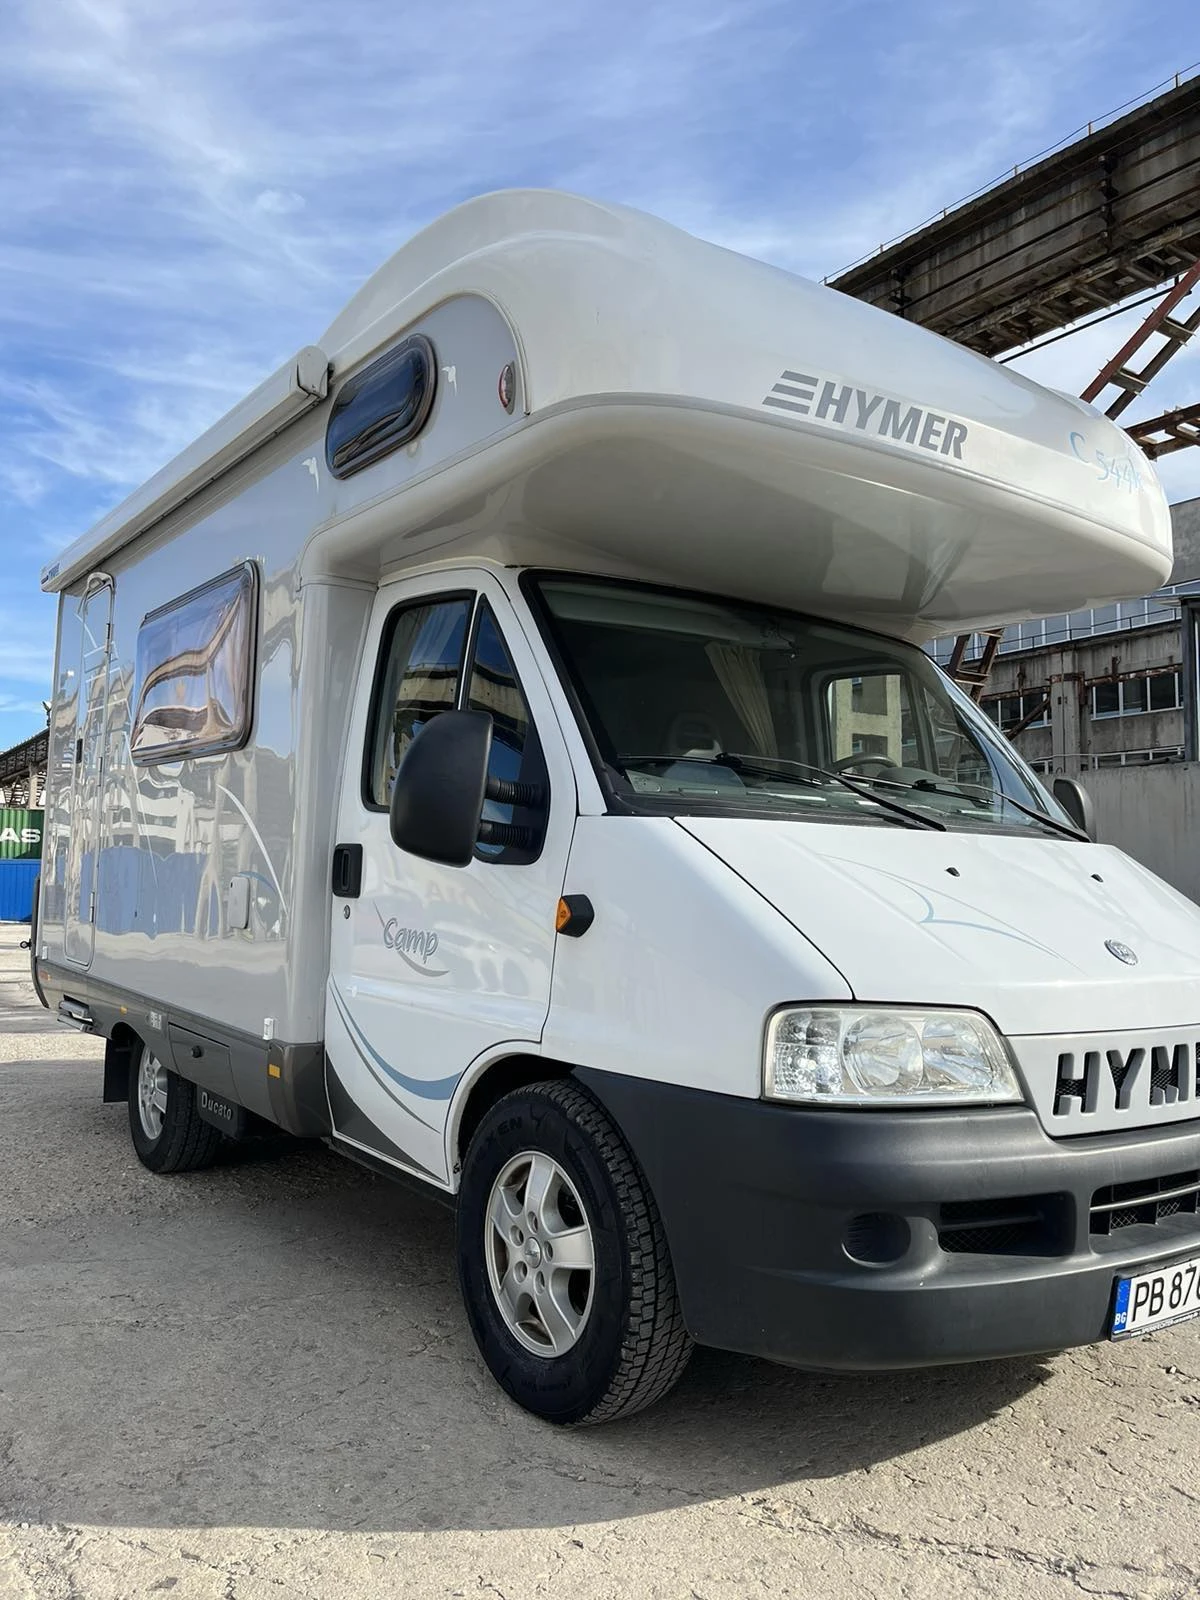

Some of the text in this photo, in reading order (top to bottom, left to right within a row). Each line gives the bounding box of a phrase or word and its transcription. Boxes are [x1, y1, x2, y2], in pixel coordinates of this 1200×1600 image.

[815, 380, 969, 460] HYMER
[1070, 431, 1089, 464] C
[383, 917, 439, 965] Camp
[1052, 1042, 1200, 1117] HYM
[201, 1091, 232, 1121] Ducato
[1131, 1265, 1200, 1323] PB 87
[1114, 1312, 1127, 1326] BG
